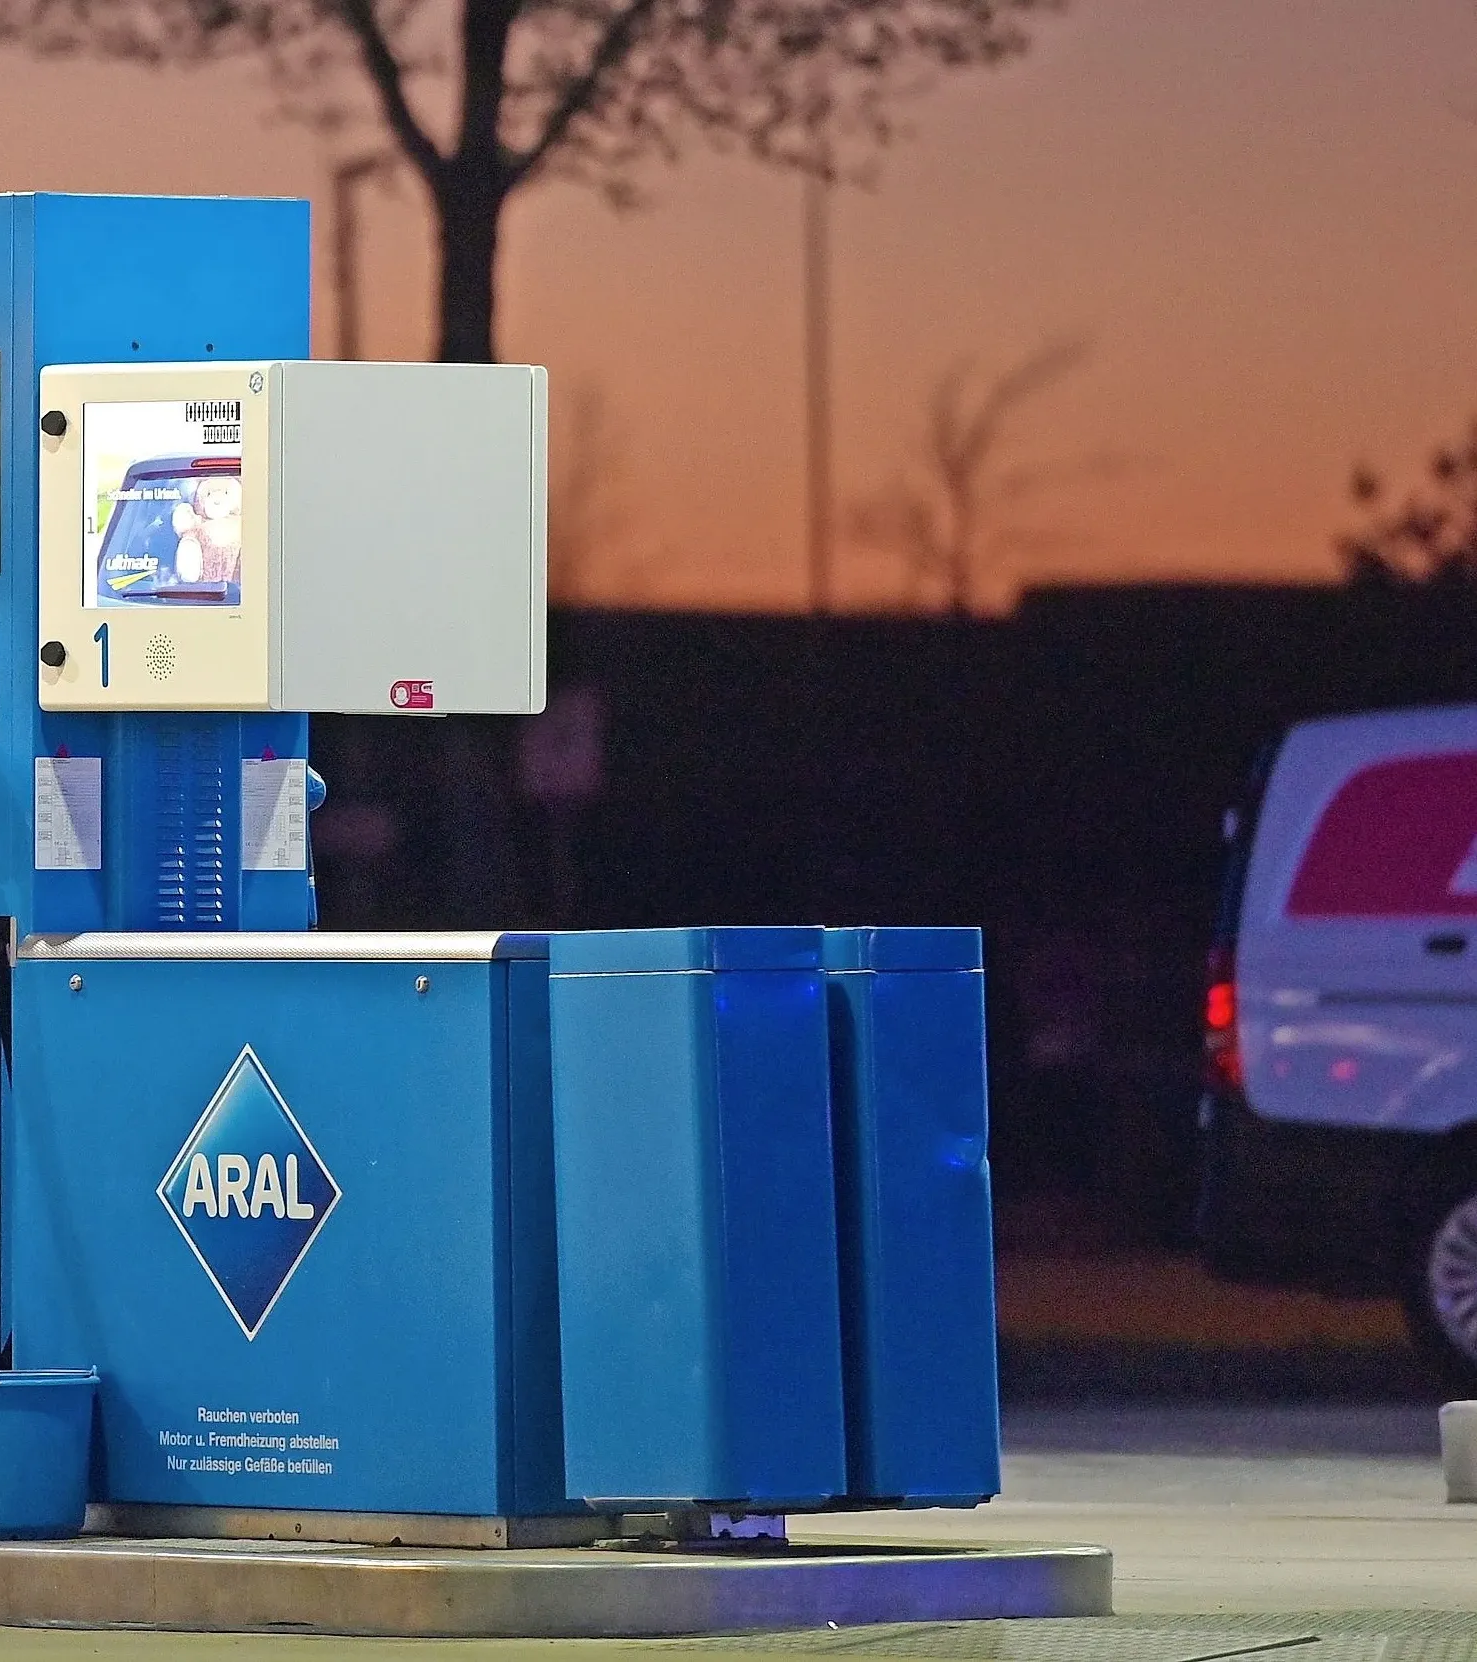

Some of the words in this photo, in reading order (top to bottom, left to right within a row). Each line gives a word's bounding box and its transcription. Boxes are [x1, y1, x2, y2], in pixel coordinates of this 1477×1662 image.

[87, 515, 95, 534] 1
[106, 554, 159, 571] ultimate
[94, 622, 109, 688] 1
[182, 1153, 314, 1219] ARAL
[198, 1407, 247, 1423] Rauchen
[250, 1409, 299, 1424] verboten
[159, 1431, 191, 1446] Motor
[196, 1435, 206, 1447] u.
[209, 1432, 285, 1451] Fremdheizung
[290, 1434, 339, 1450] abstellen
[167, 1456, 187, 1470] Nur
[190, 1456, 241, 1475] zulässige
[245, 1457, 285, 1473] Gefäße
[287, 1458, 333, 1474] befüllen
